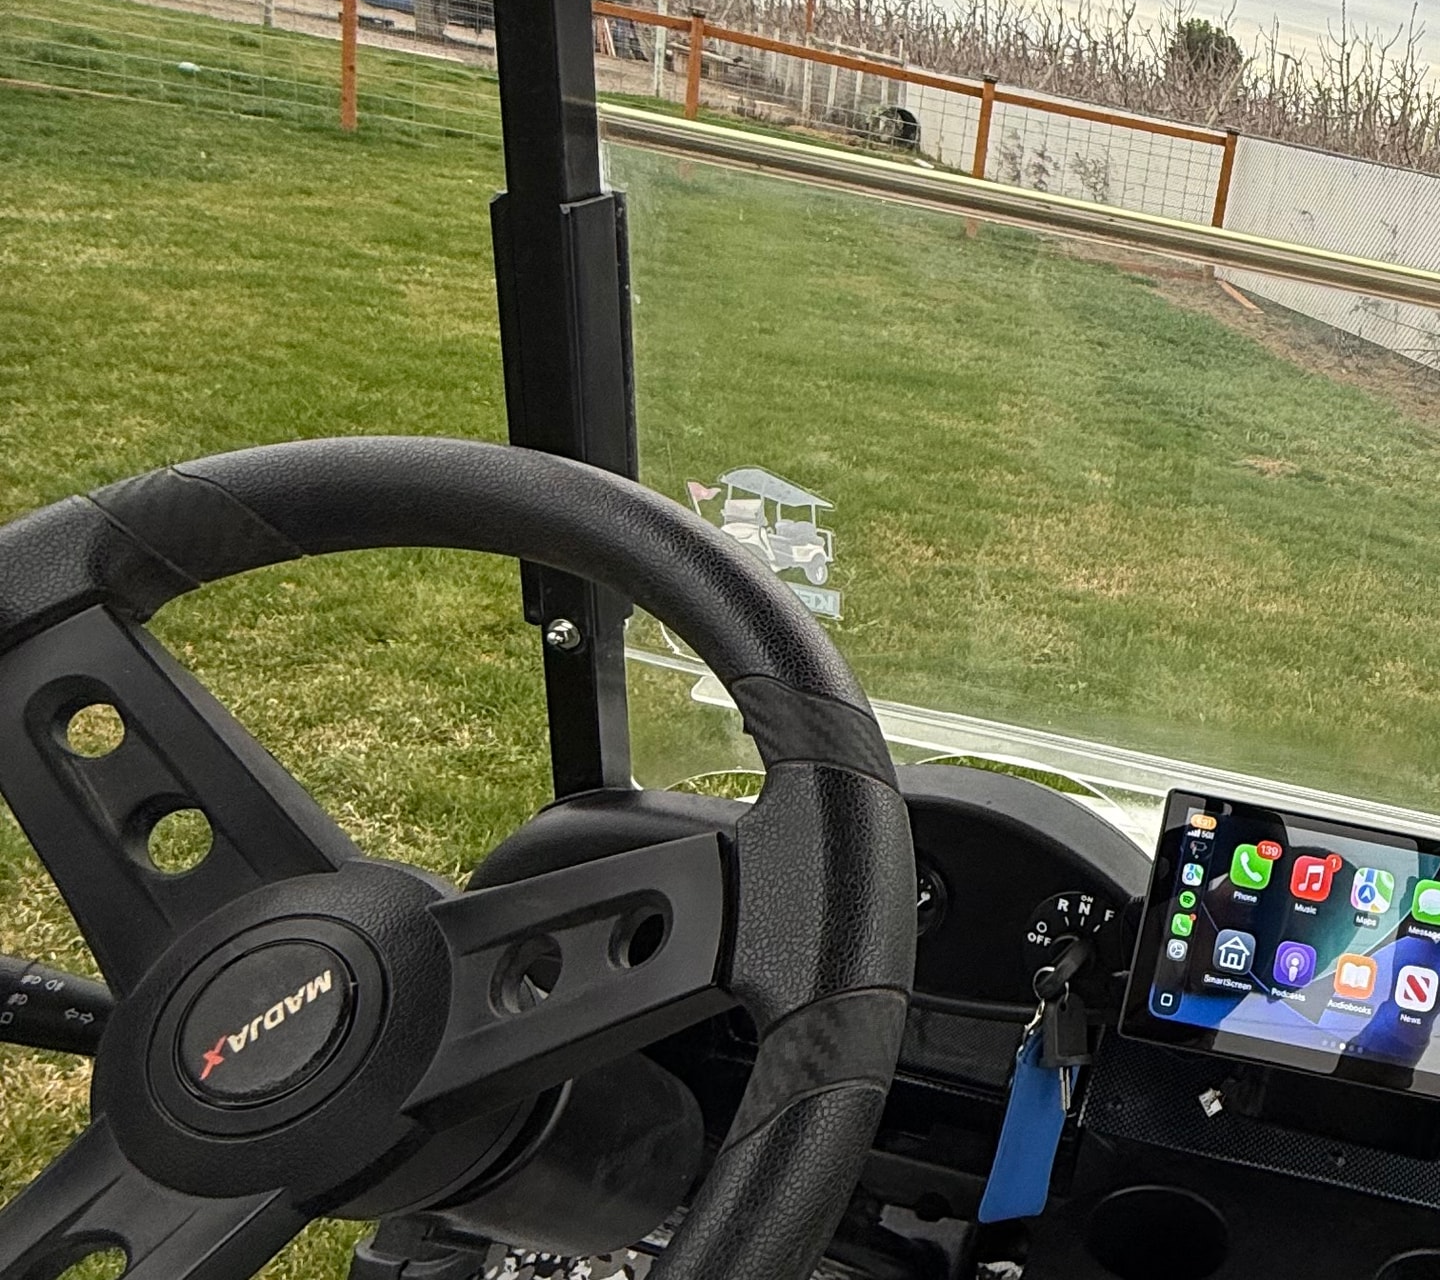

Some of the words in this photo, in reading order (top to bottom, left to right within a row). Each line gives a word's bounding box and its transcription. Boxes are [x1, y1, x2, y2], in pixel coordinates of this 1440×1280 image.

[1260, 845, 1279, 856] 139
[1080, 895, 1093, 903] ON
[1233, 890, 1258, 903] Phone
[1057, 898, 1069, 911] R
[1078, 903, 1091, 915] N
[1294, 903, 1317, 915] Music
[1104, 910, 1114, 921] F
[1355, 916, 1377, 927] Maps
[1027, 932, 1052, 947] OFF
[1203, 974, 1252, 991] SmartScreen
[1271, 987, 1306, 1002] Podcasts
[1327, 1000, 1372, 1016] Audiobooks
[1399, 1014, 1422, 1025] News
